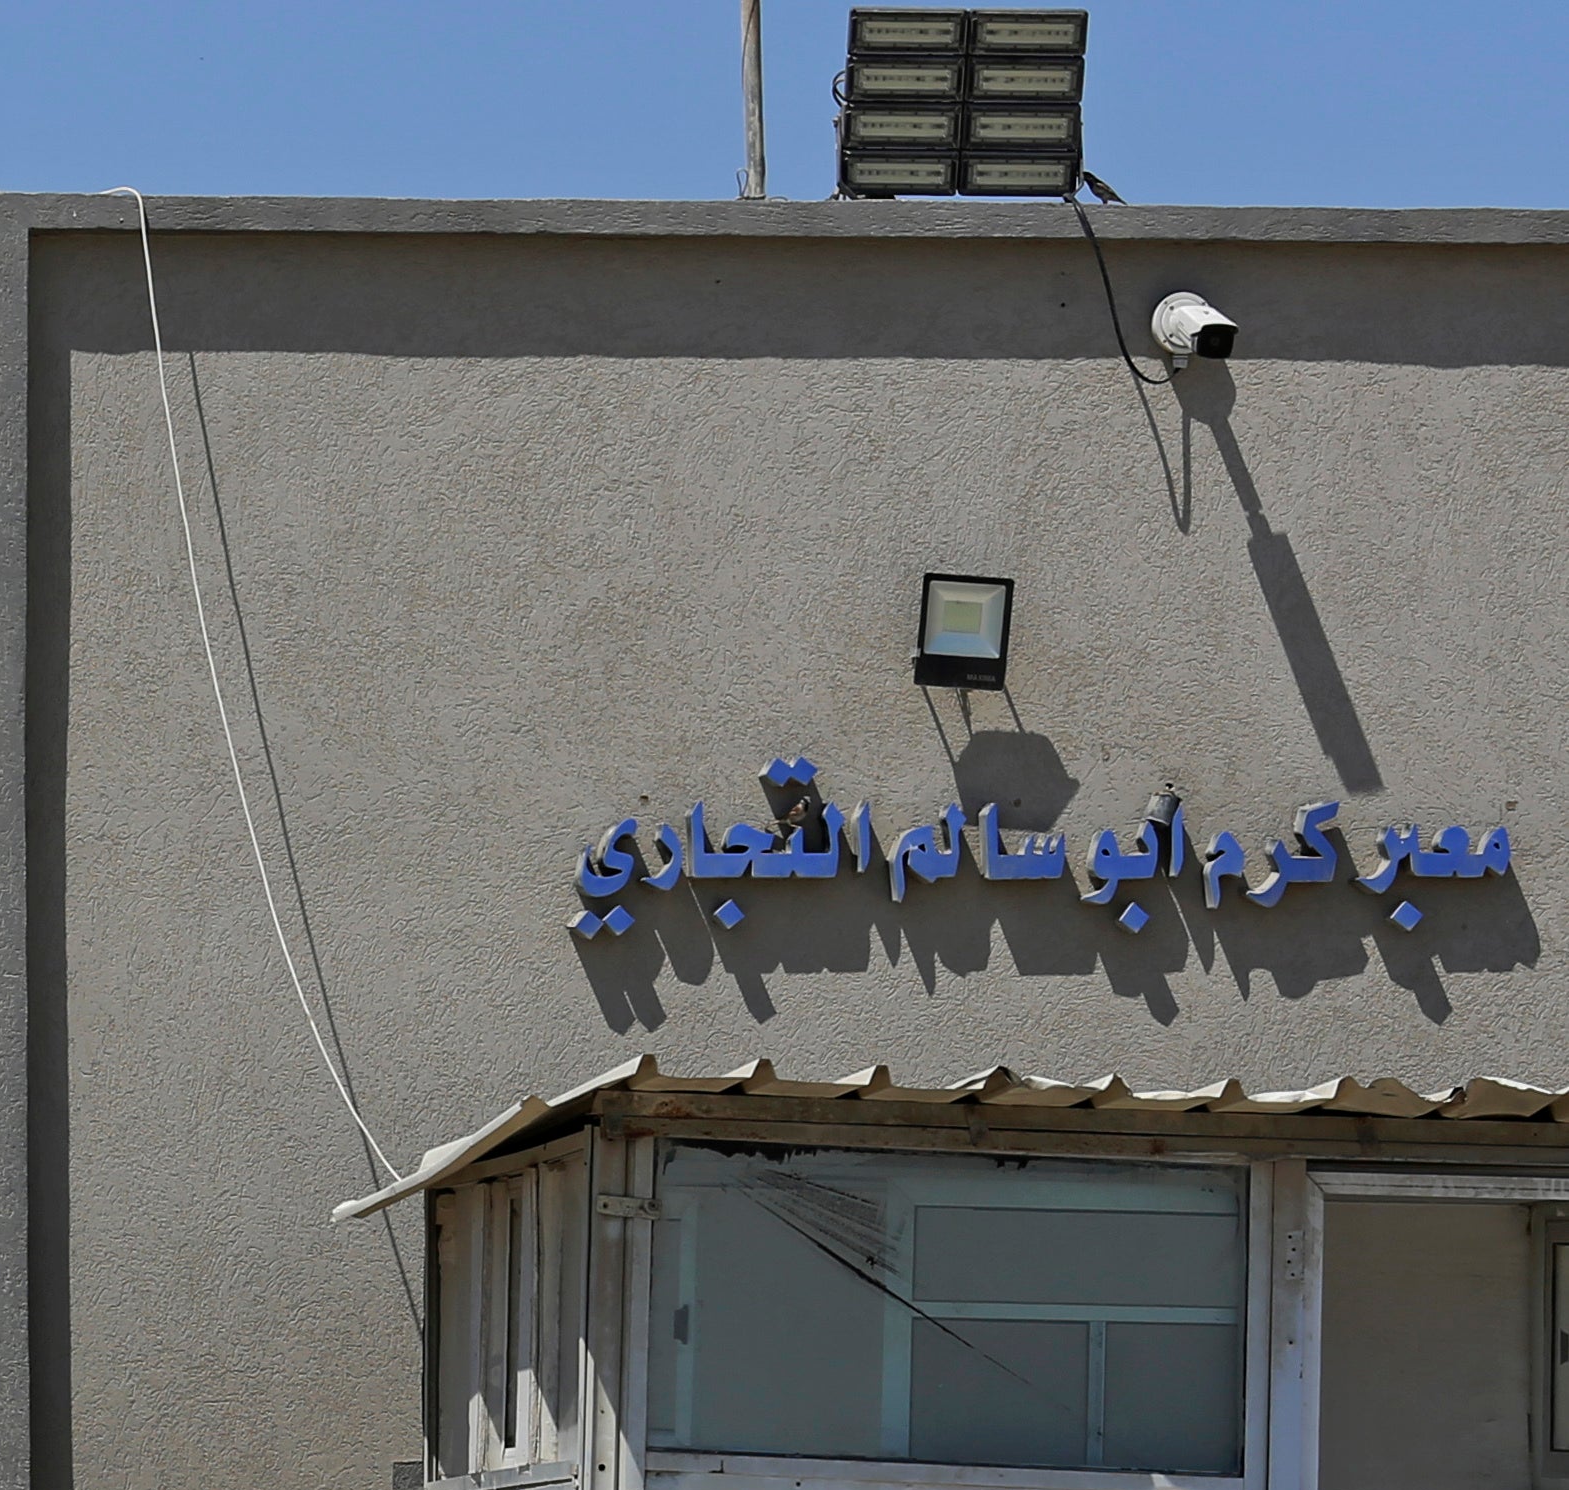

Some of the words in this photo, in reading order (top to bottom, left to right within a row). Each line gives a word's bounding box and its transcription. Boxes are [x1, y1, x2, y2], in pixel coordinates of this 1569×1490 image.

[566, 756, 871, 940] التجاري
[886, 801, 1065, 903] سالم
[1080, 803, 1184, 934] ابو
[1202, 800, 1340, 909] كرم
[1357, 823, 1511, 932] معبر
